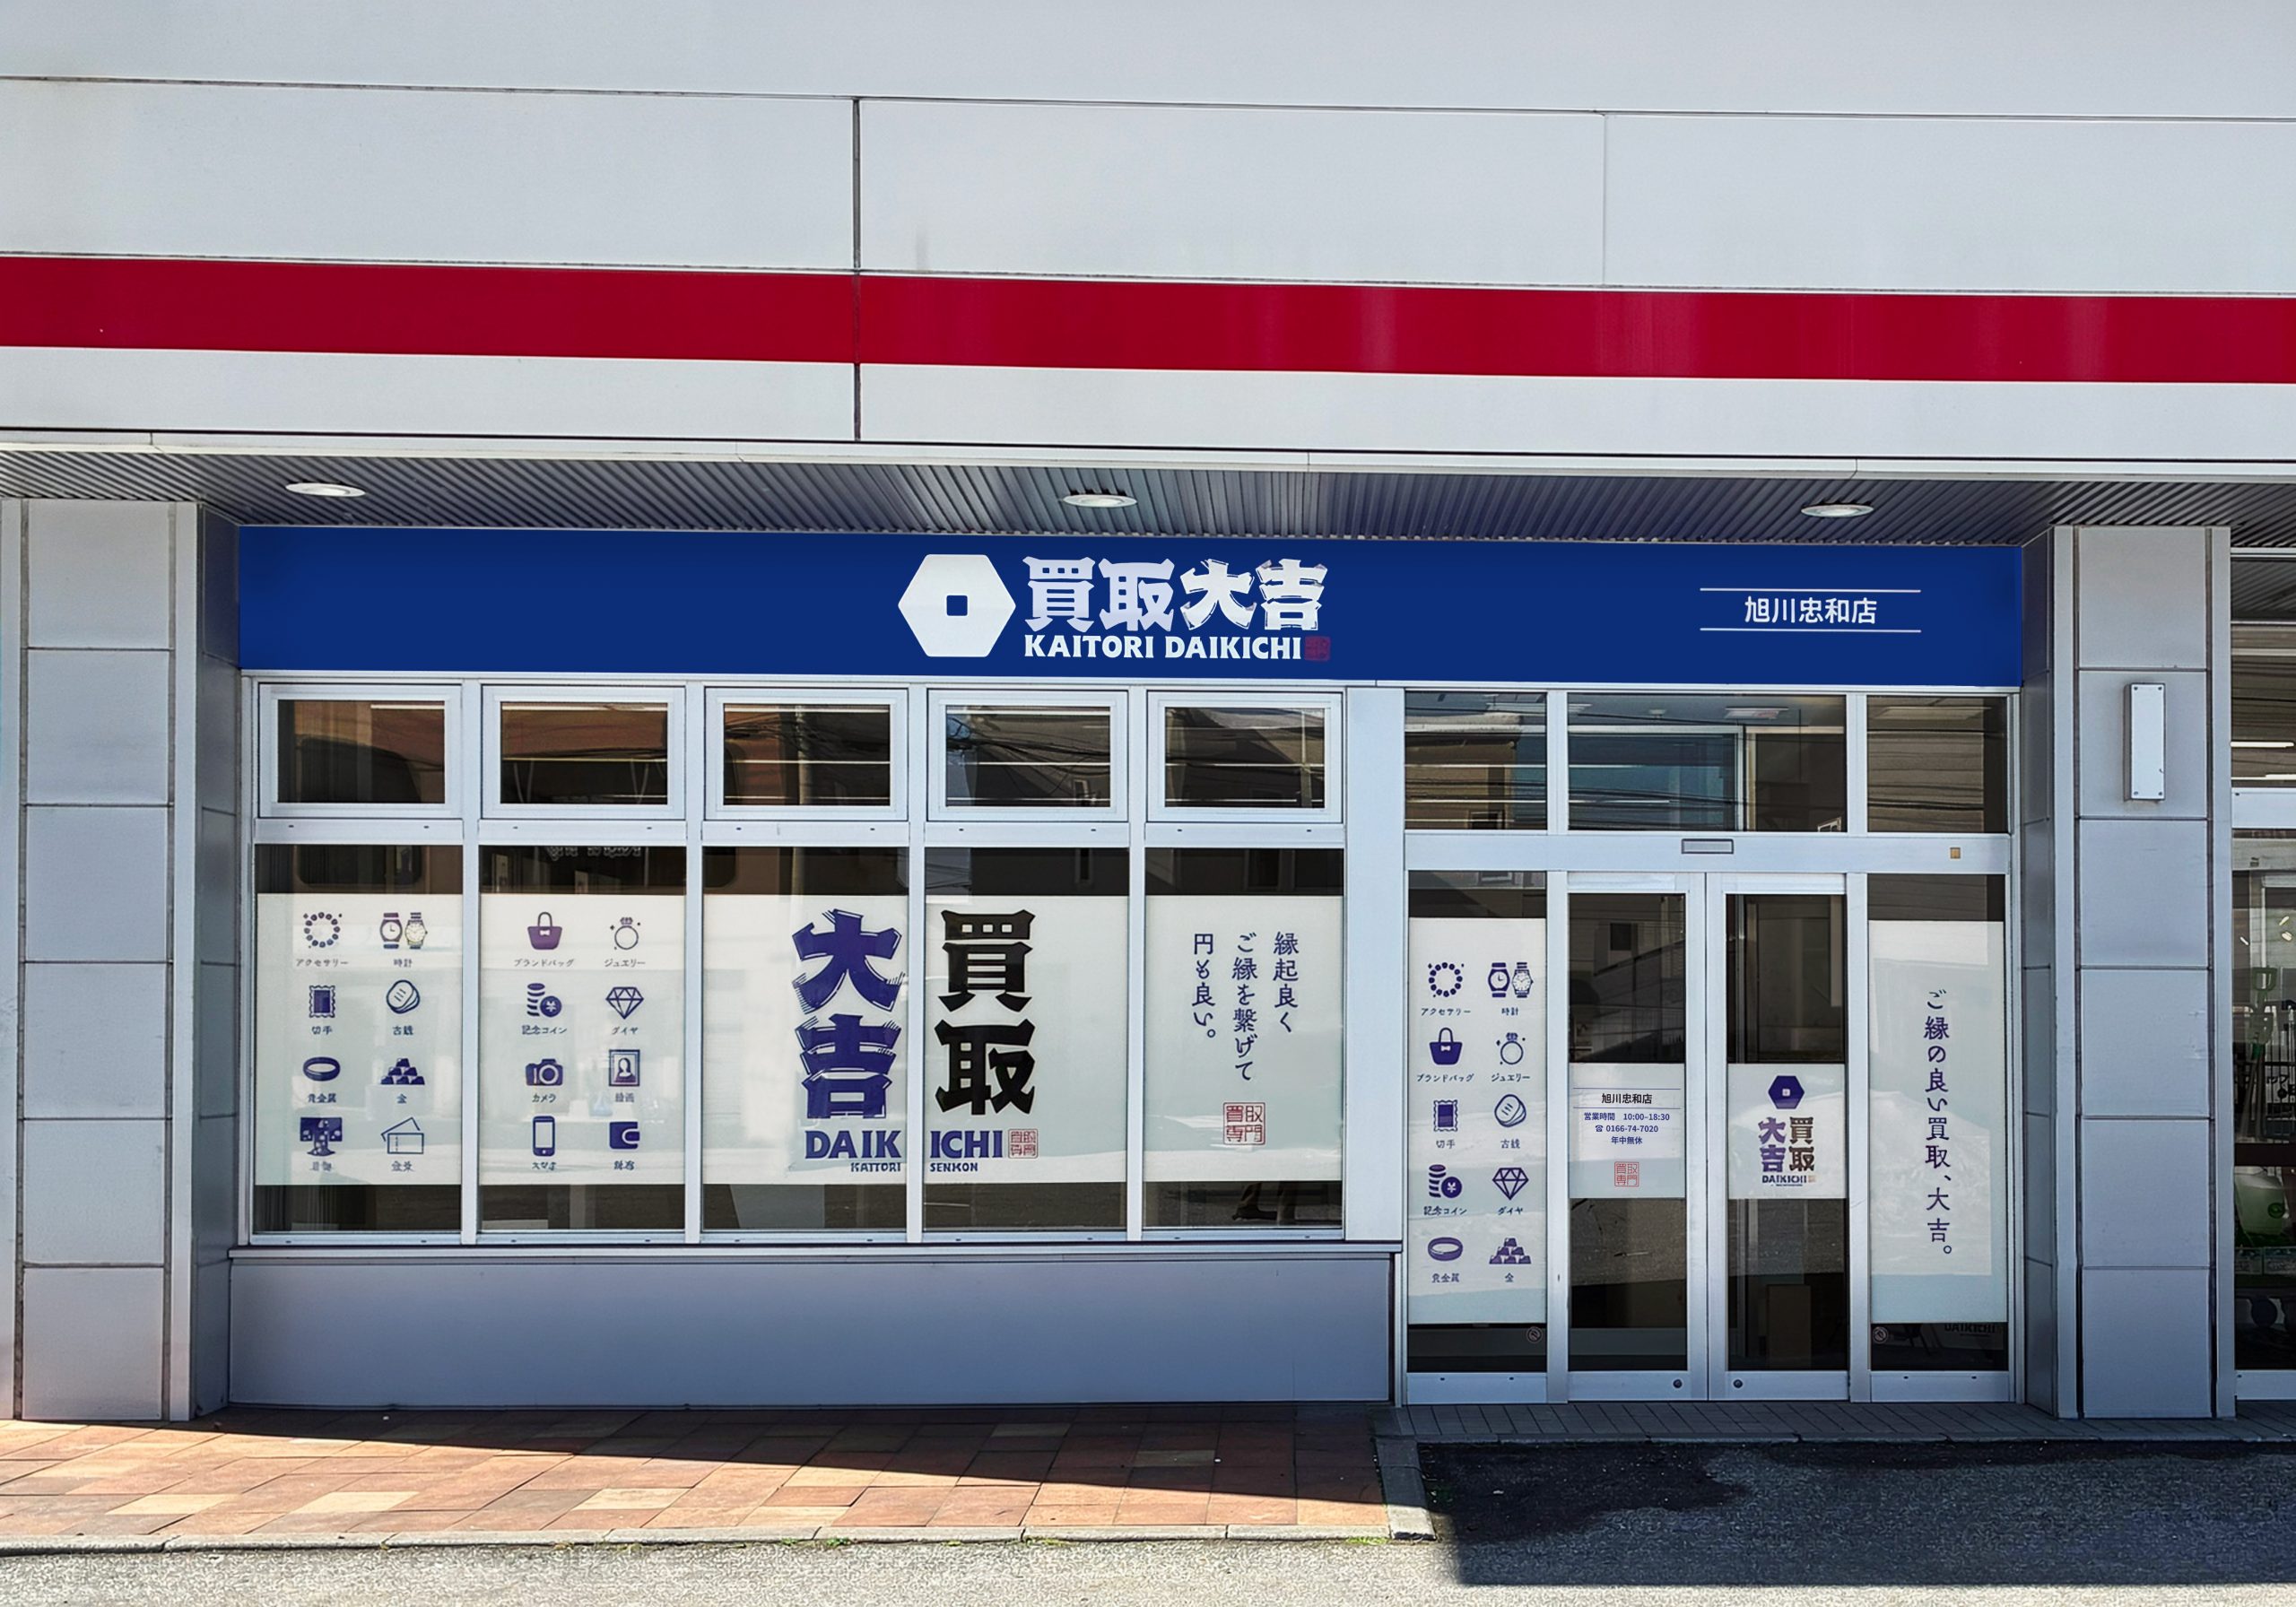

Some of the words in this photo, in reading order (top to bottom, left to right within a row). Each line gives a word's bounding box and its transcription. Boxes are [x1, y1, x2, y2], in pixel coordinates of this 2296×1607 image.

[1022, 556, 1328, 632] 買取大吉
[1744, 595, 1877, 624] 旭川忠和店
[1024, 634, 1154, 658] KAITORI
[1164, 636, 1301, 660] DAIKICHI
[1191, 933, 1216, 1038] 円も良い。
[1231, 932, 1258, 1081] ご縁を繋げて
[1272, 931, 1300, 1033] 縁起良く
[792, 908, 906, 1119] 大吉
[935, 909, 1036, 1116] 買取
[1583, 1112, 1615, 1121] 営業時間
[1601, 1092, 1653, 1105] 旭川忠和店
[1923, 989, 1952, 1255] ご縁の良い買取、大吉。
[1605, 1125, 1659, 1133] 0166-74-7020
[1611, 1135, 1643, 1145] 年中無休
[1758, 1116, 1787, 1173] 大吉
[1789, 1116, 1815, 1172] 買取
